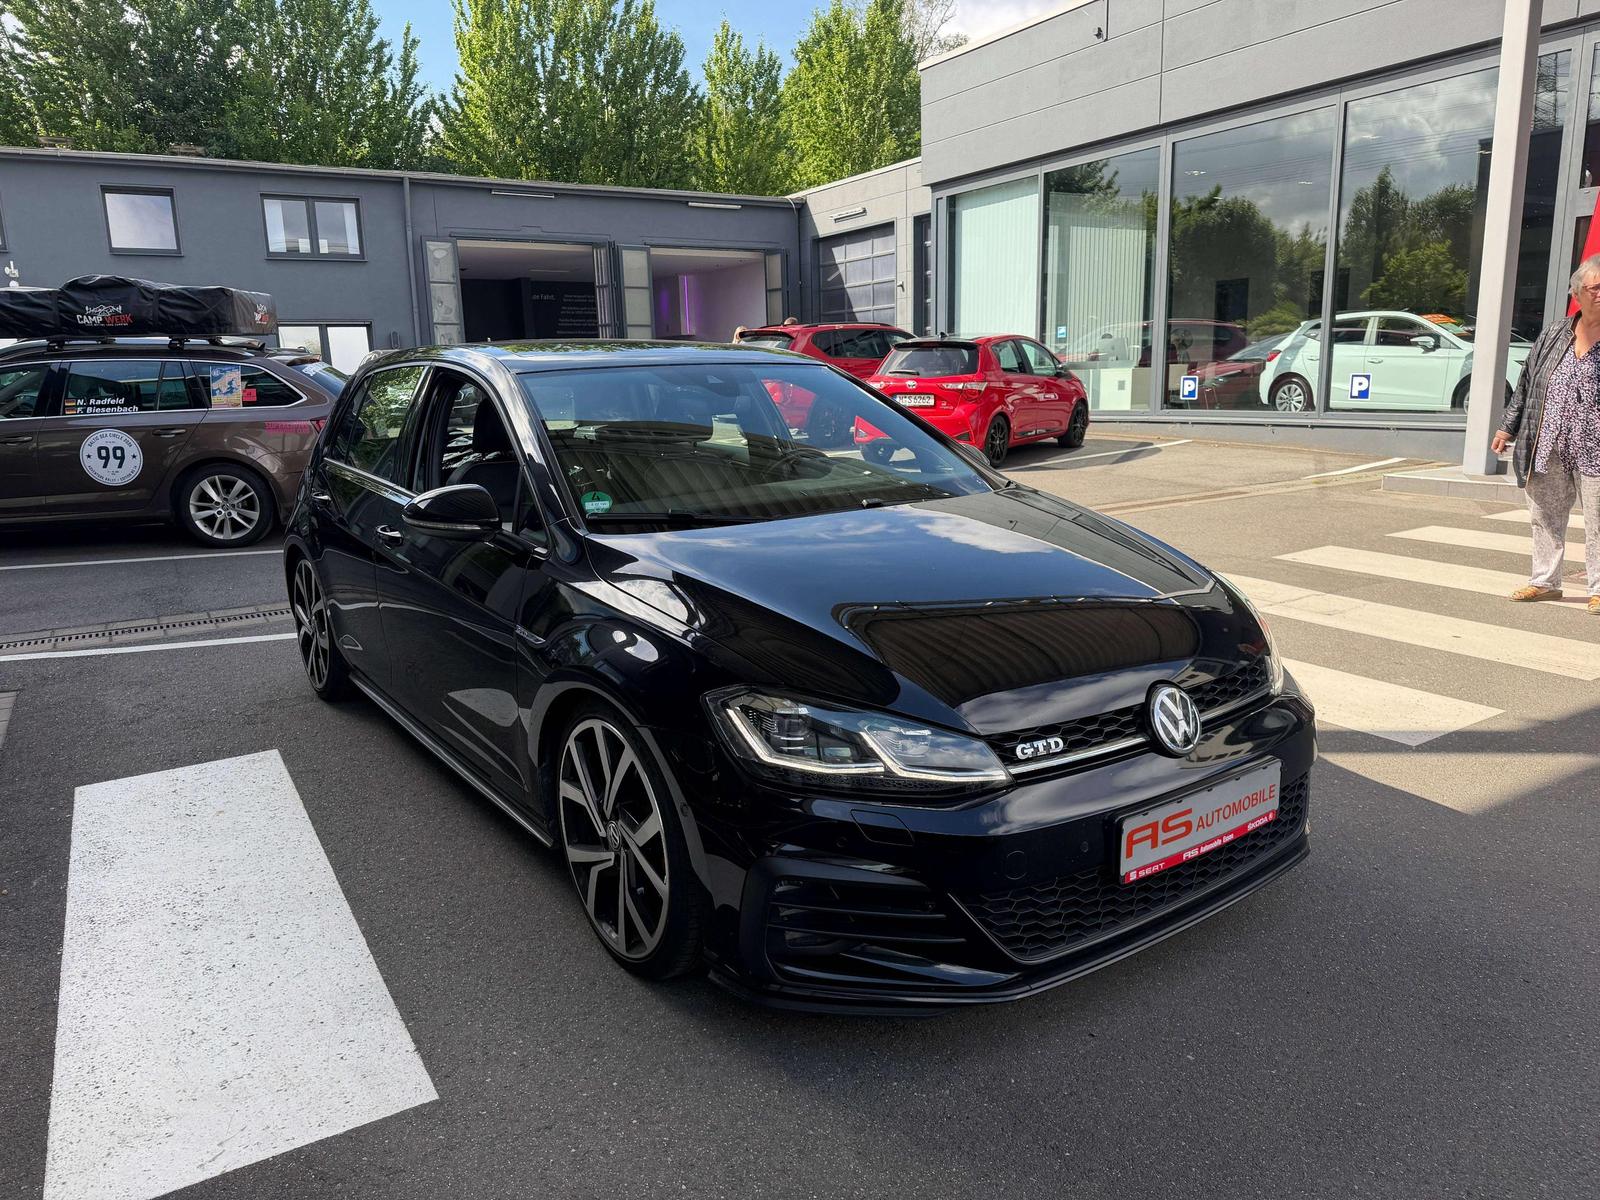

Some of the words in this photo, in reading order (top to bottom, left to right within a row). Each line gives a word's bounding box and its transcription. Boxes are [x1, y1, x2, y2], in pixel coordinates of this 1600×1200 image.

[76, 314, 102, 325] CAMP
[105, 313, 133, 324] WERK
[1351, 376, 1369, 397] P
[76, 398, 87, 406] N.
[89, 397, 125, 405] Radfeld
[913, 395, 931, 404] 6262
[86, 405, 139, 414] Biesenbach
[97, 445, 126, 469] 99
[591, 491, 601, 501] 4
[1015, 736, 1065, 760] GTD
[1125, 807, 1193, 859] AS
[1196, 783, 1277, 832] AUTOMOBILE
[1183, 847, 1200, 860] AS
[1138, 862, 1166, 877] SEAT
